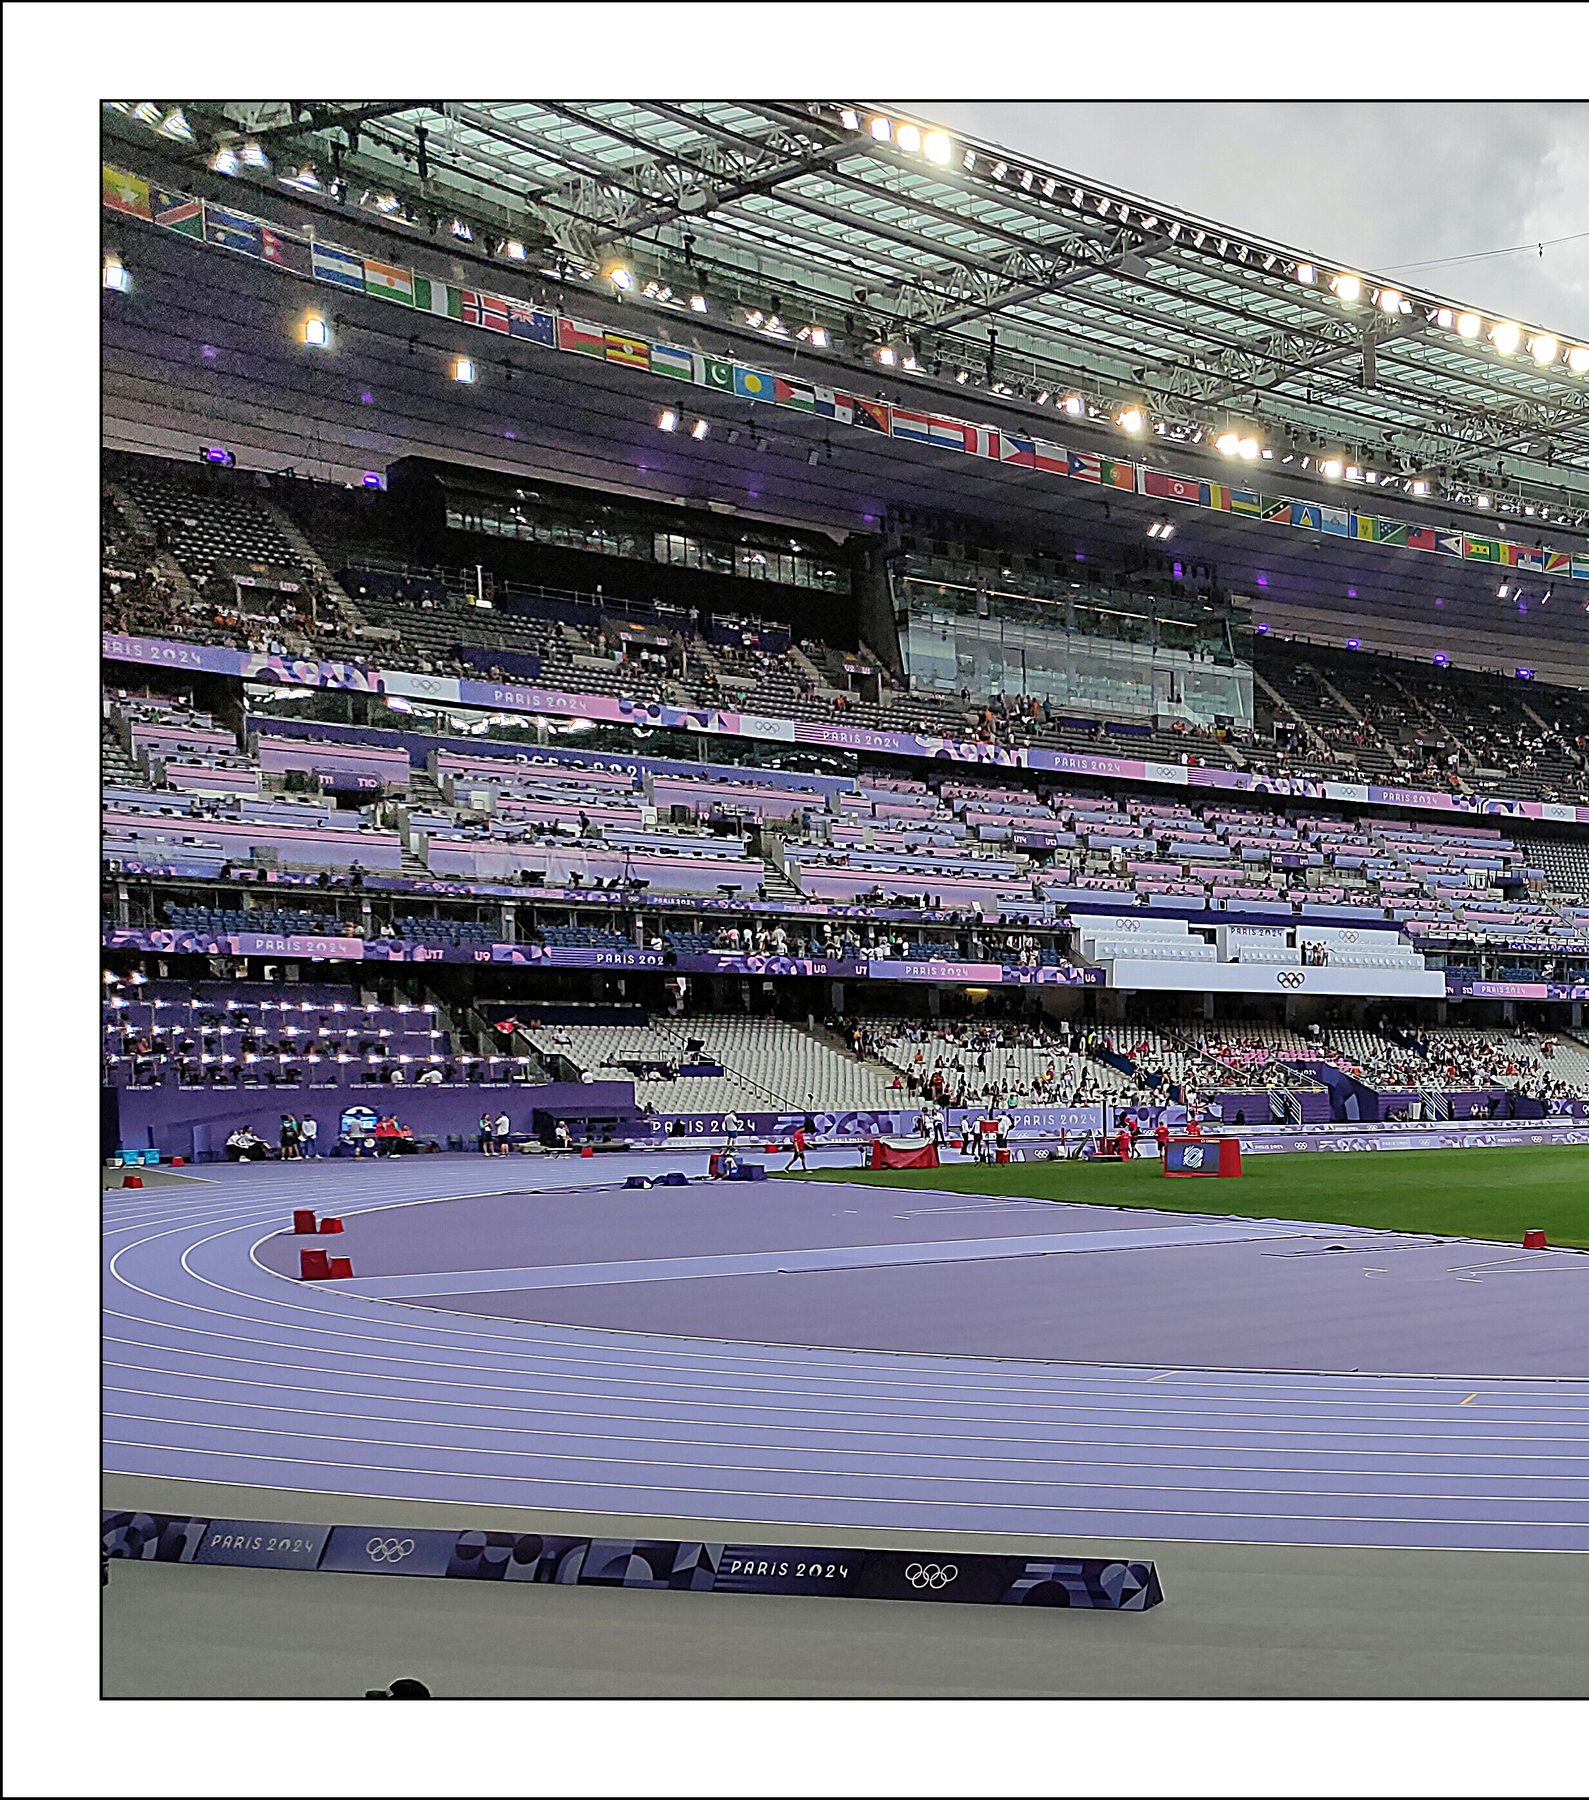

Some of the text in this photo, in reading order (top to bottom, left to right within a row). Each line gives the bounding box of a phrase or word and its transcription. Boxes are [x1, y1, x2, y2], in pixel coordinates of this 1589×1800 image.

[151, 648, 200, 664] 2024
[494, 690, 587, 711] PARIS 2024
[822, 731, 900, 748] PARIS 2024
[1054, 757, 1120, 772] PARIS 2024
[1382, 792, 1438, 804] PARIS 2024
[699, 812, 710, 820] T9
[1260, 930, 1282, 938] 2024
[256, 939, 347, 953] PARIS 2024
[424, 950, 490, 961] U17 U9
[597, 954, 664, 966] PARIS 202
[814, 964, 868, 975] U8 U7
[906, 966, 968, 977] PARIS 2024
[1085, 973, 1096, 982] U6
[1506, 986, 1526, 994] 2024
[1014, 1113, 1096, 1126] PARIS 2024
[652, 1120, 704, 1134] PAIS
[210, 1534, 314, 1554] PARIS 2024
[730, 1560, 848, 1579] PARIS 2024
